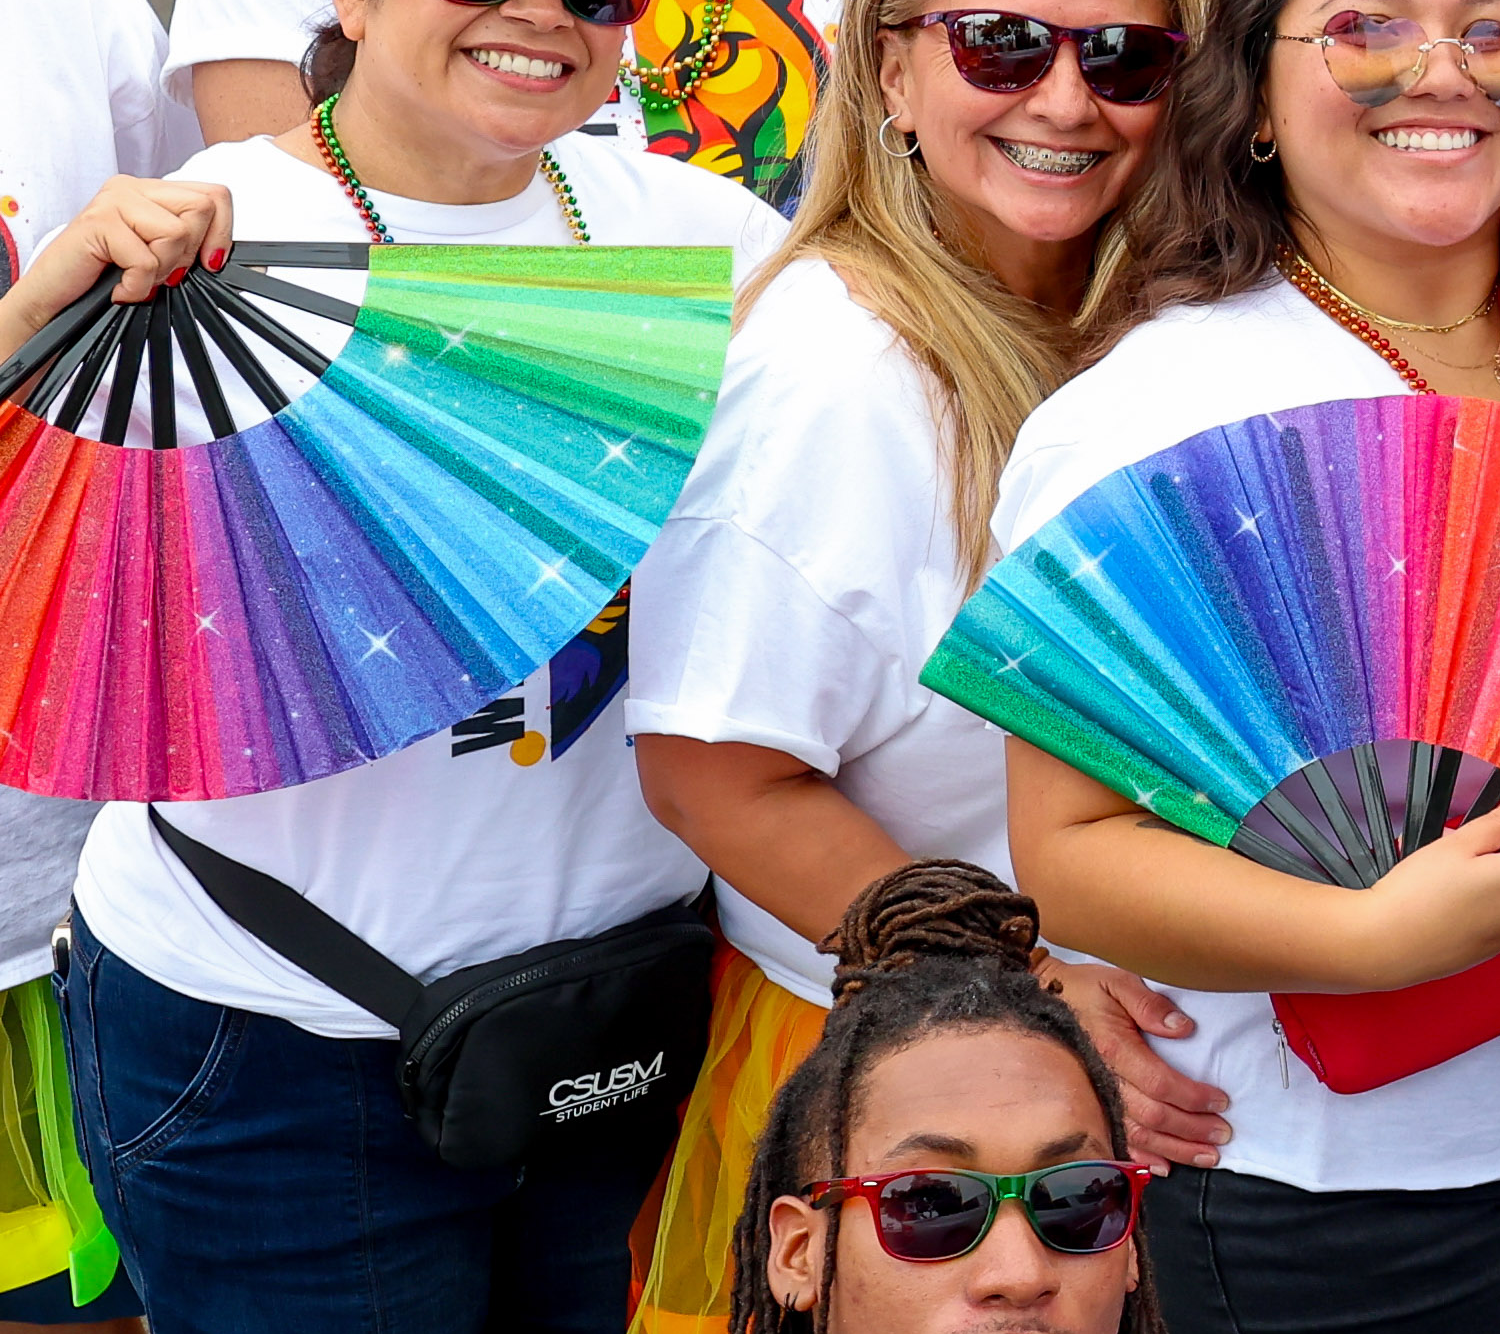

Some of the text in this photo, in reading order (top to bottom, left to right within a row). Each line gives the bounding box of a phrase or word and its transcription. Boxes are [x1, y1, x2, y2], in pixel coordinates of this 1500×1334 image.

[549, 1051, 665, 1107] CSUSM
[555, 1084, 650, 1123] STUDENT LIFE
